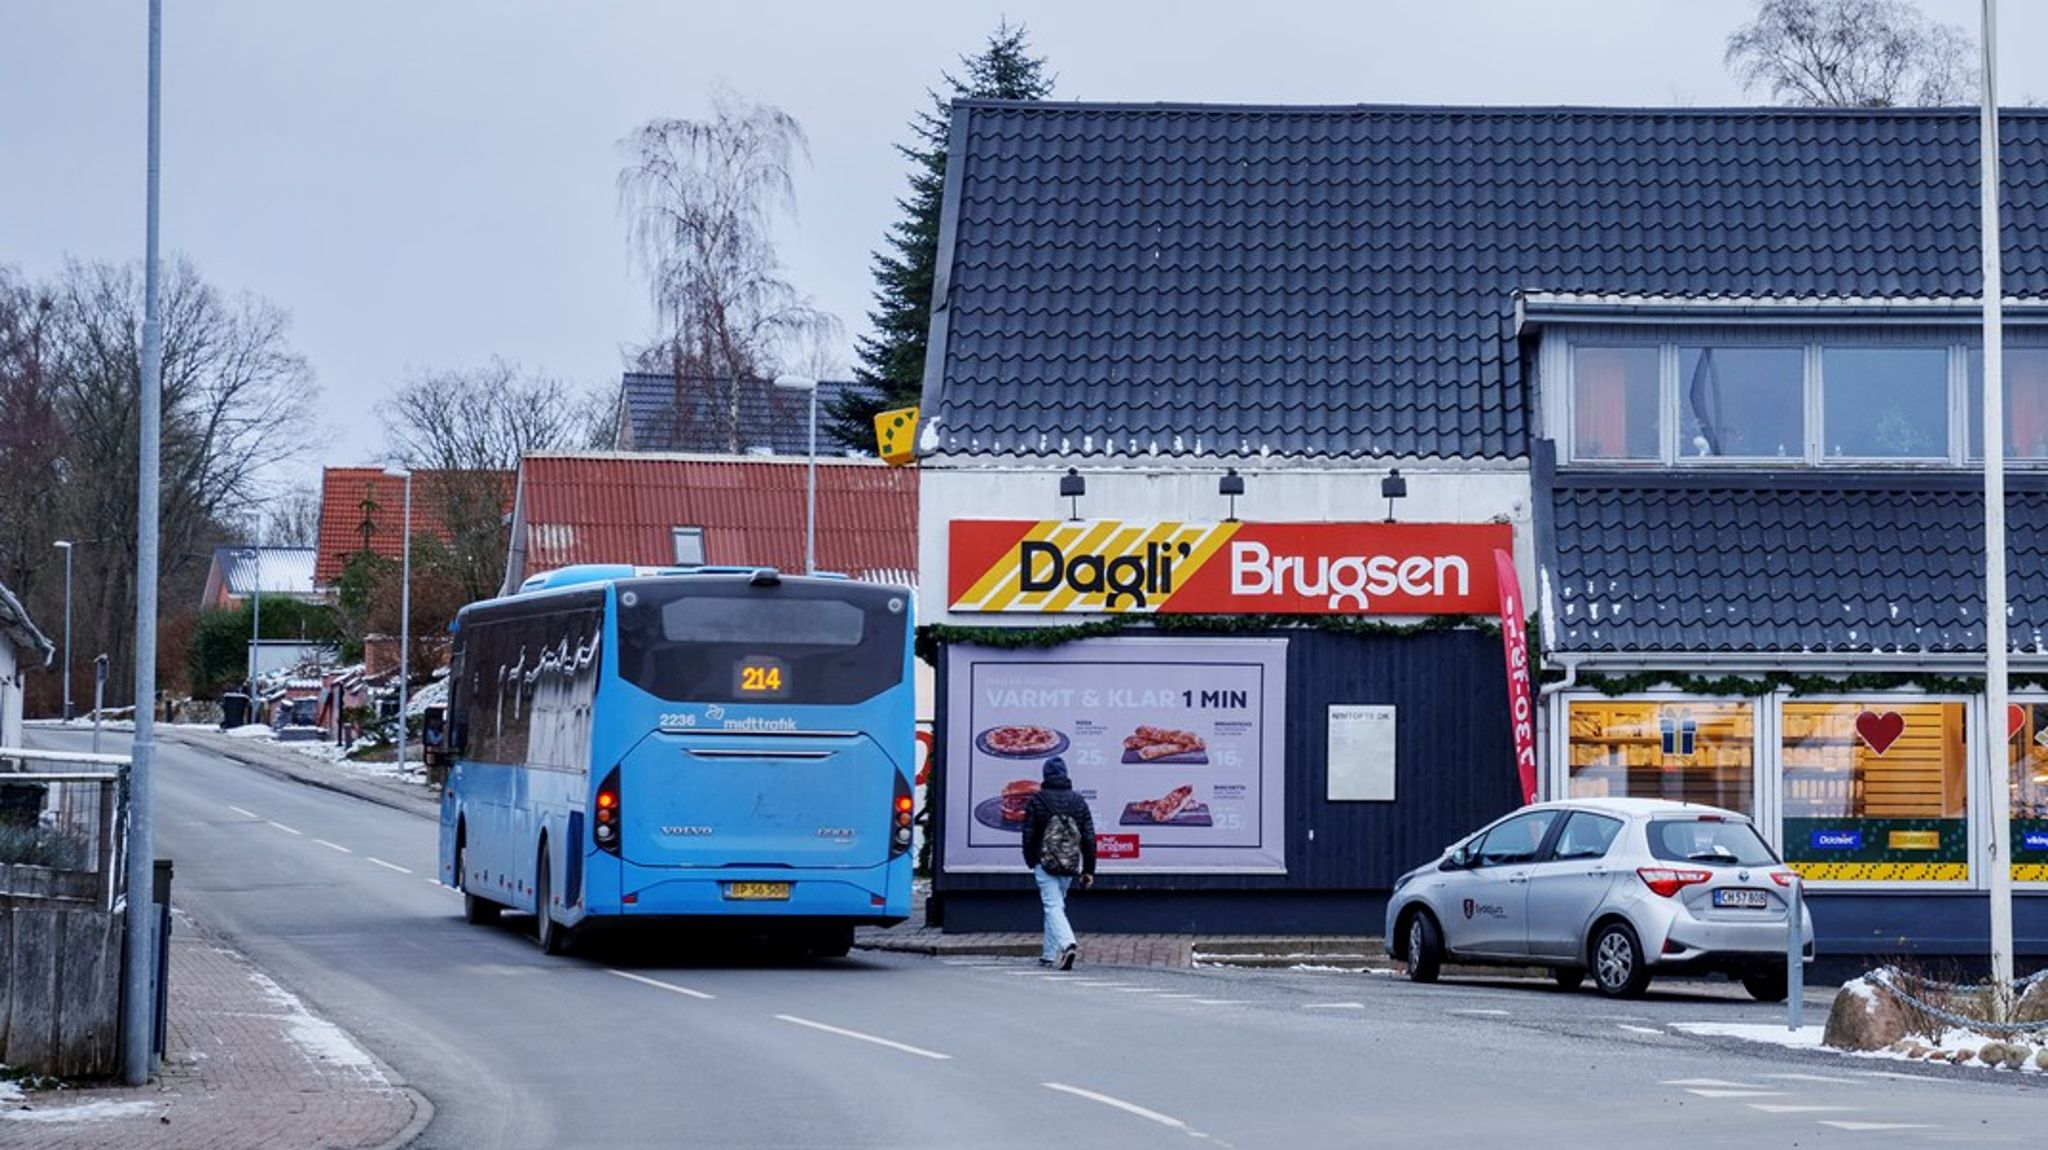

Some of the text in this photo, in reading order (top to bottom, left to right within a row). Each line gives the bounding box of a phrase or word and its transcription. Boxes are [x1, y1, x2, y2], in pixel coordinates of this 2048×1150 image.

[1020, 541, 1469, 609] Dagli' Brugsen
[741, 667, 781, 690] 214
[986, 689, 1247, 709] VARMT & KLAR 1 MIN
[660, 714, 696, 726] 2236
[724, 717, 797, 731] midttrafik
[661, 826, 713, 835] VOLVO
[750, 883, 764, 898] 56
[1722, 891, 1734, 903] CH
[1736, 891, 1746, 903] 57
